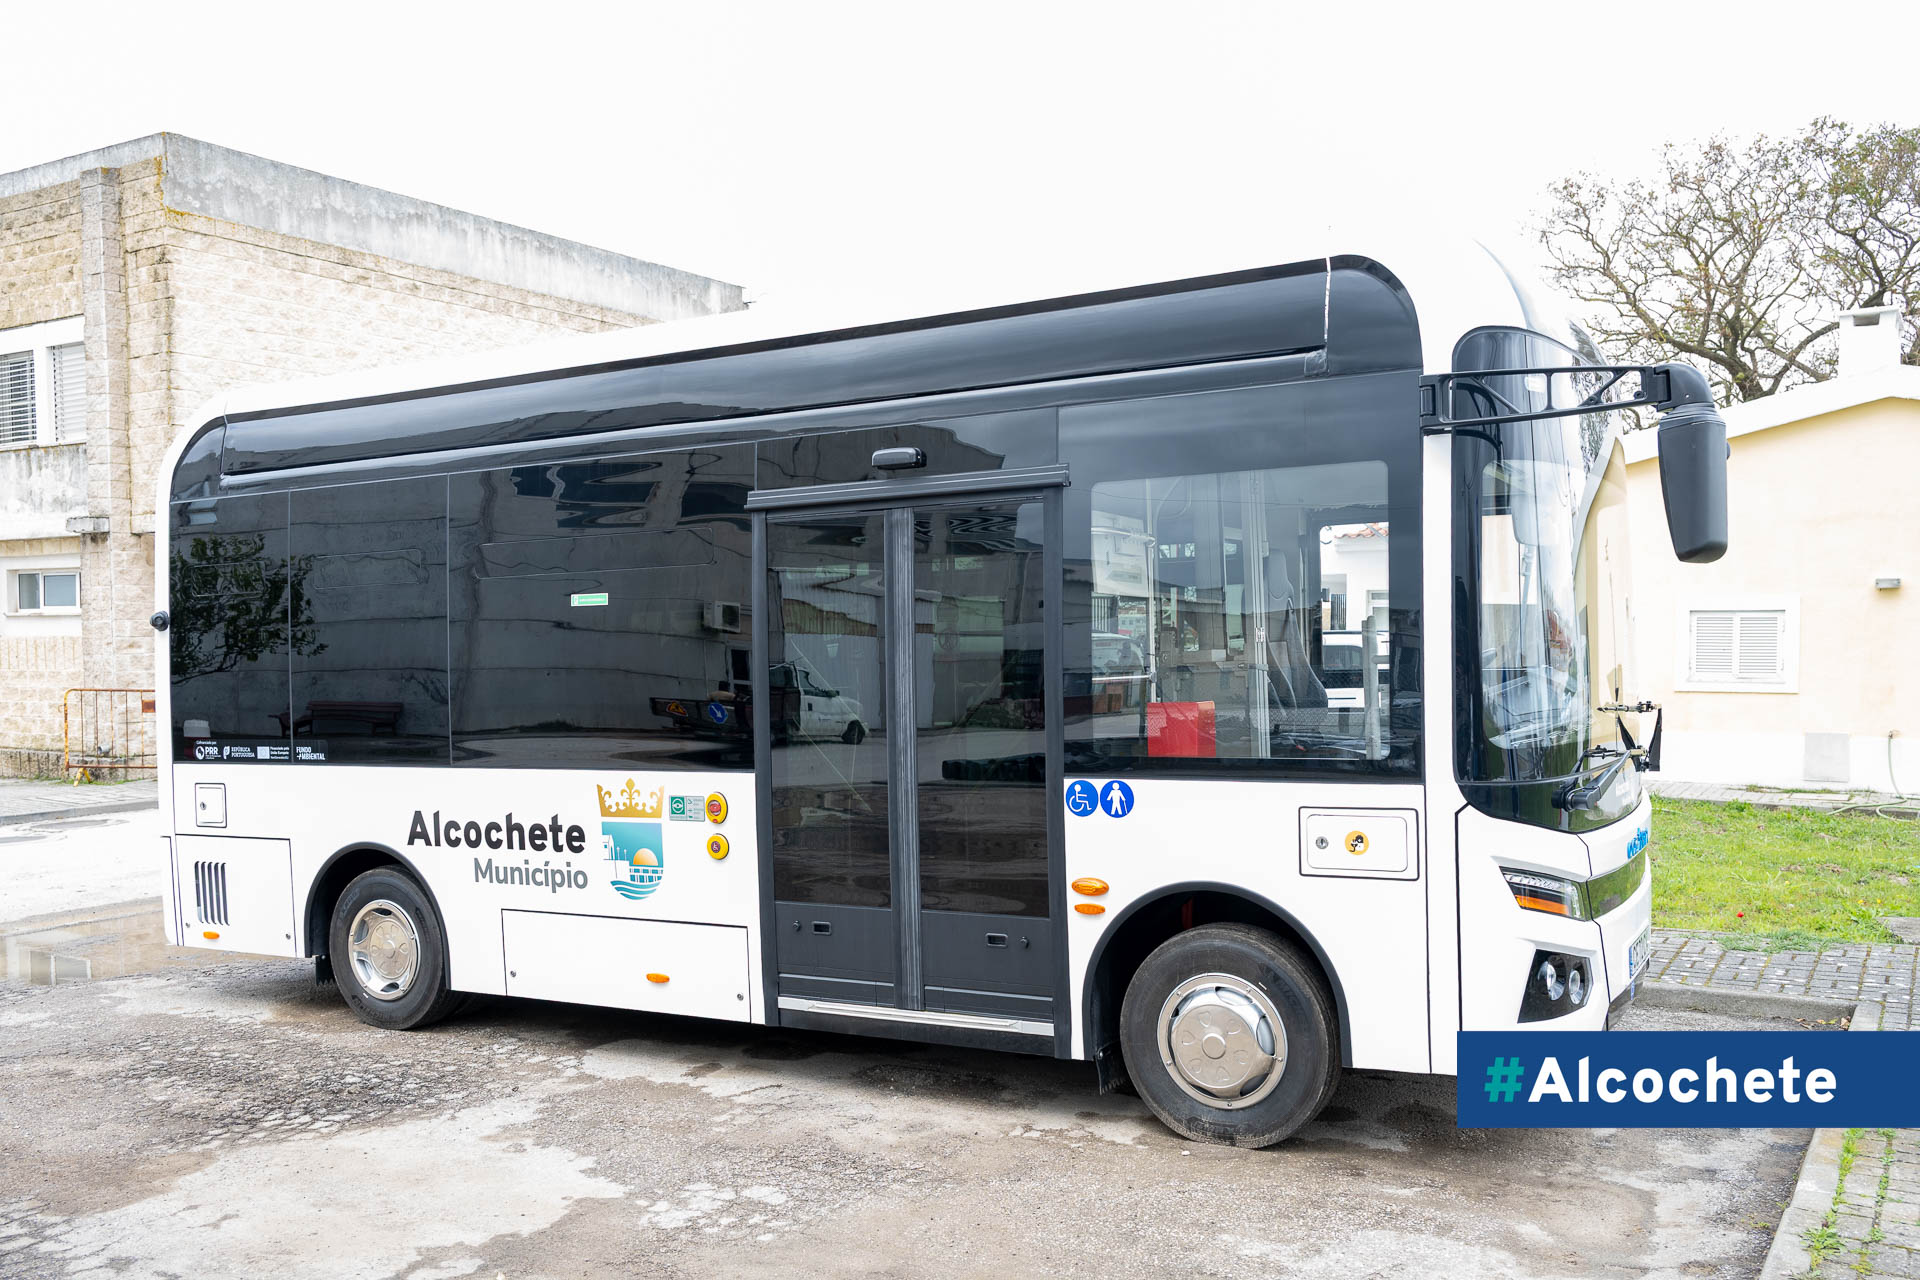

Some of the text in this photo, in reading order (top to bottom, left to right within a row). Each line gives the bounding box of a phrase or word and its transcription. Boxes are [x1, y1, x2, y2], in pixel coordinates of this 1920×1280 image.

[205, 746, 218, 755] PRR
[407, 810, 586, 854] Alcochete
[473, 858, 588, 893] Município
